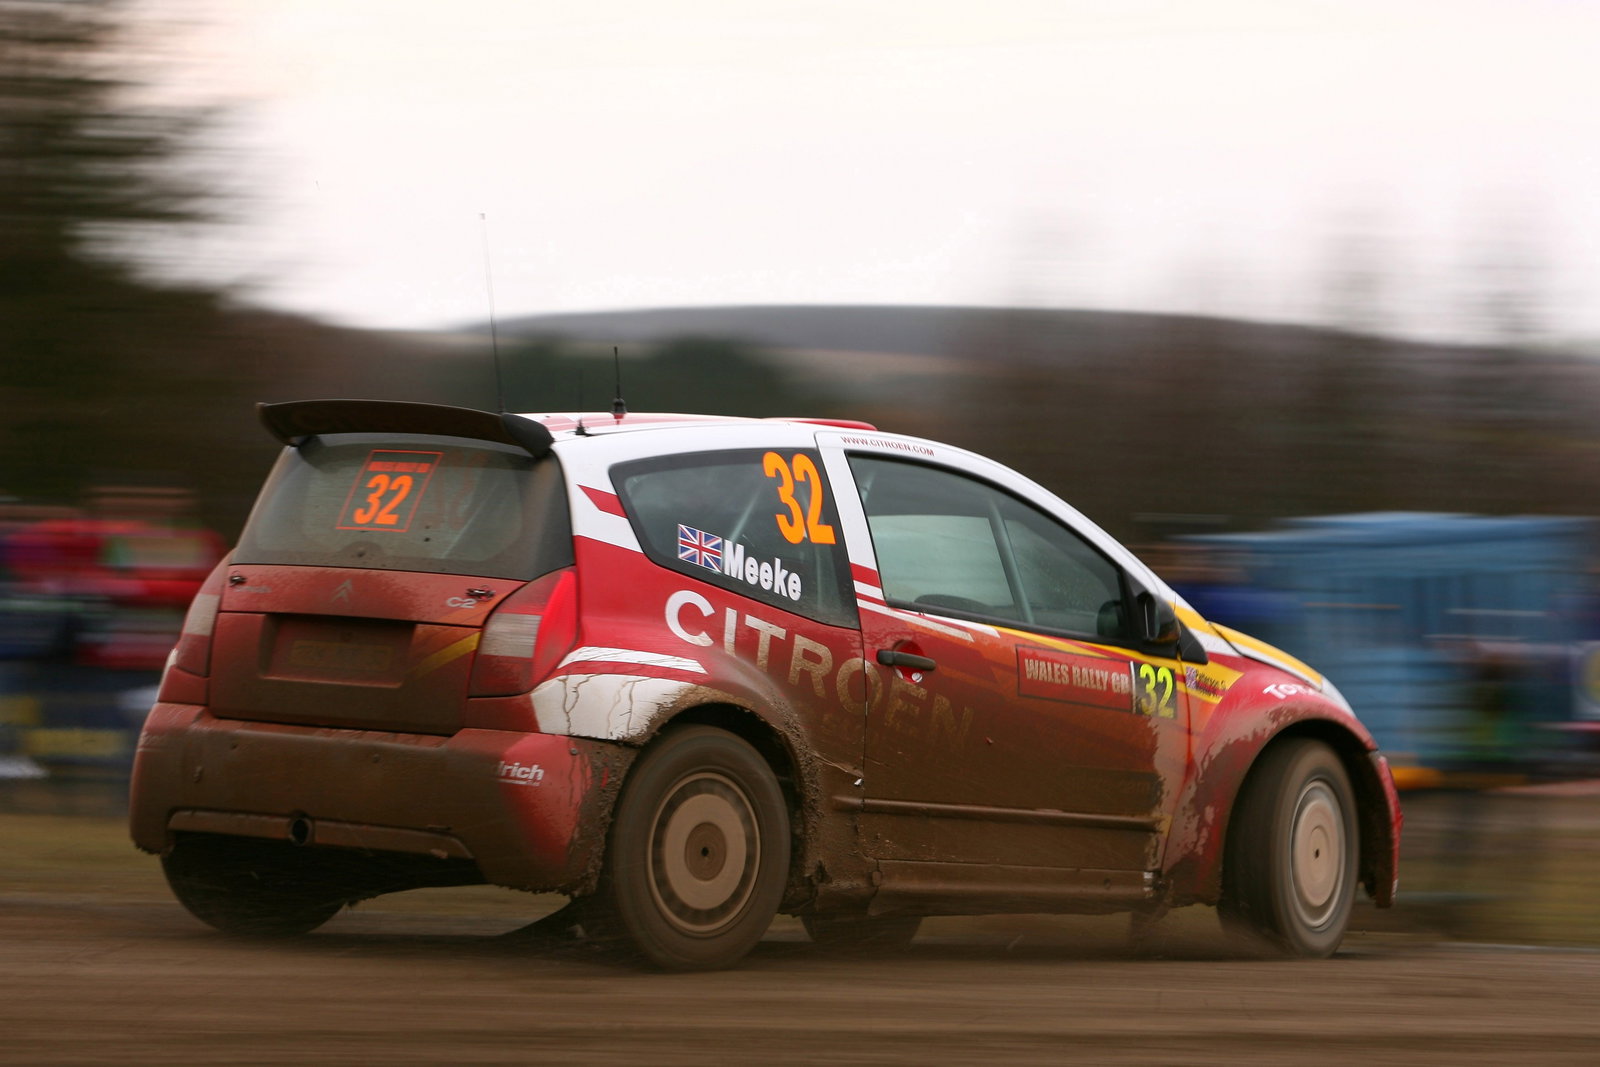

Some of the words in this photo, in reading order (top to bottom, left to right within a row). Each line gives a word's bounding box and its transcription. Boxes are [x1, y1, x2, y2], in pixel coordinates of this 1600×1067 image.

[353, 473, 414, 526] 32
[763, 451, 836, 545] 32
[724, 539, 802, 601] Meeke
[446, 596, 477, 609] C2
[1024, 658, 1070, 685] WALES
[1071, 665, 1109, 692] RALLY
[1111, 671, 1131, 694] GB
[1139, 663, 1175, 719] 32
